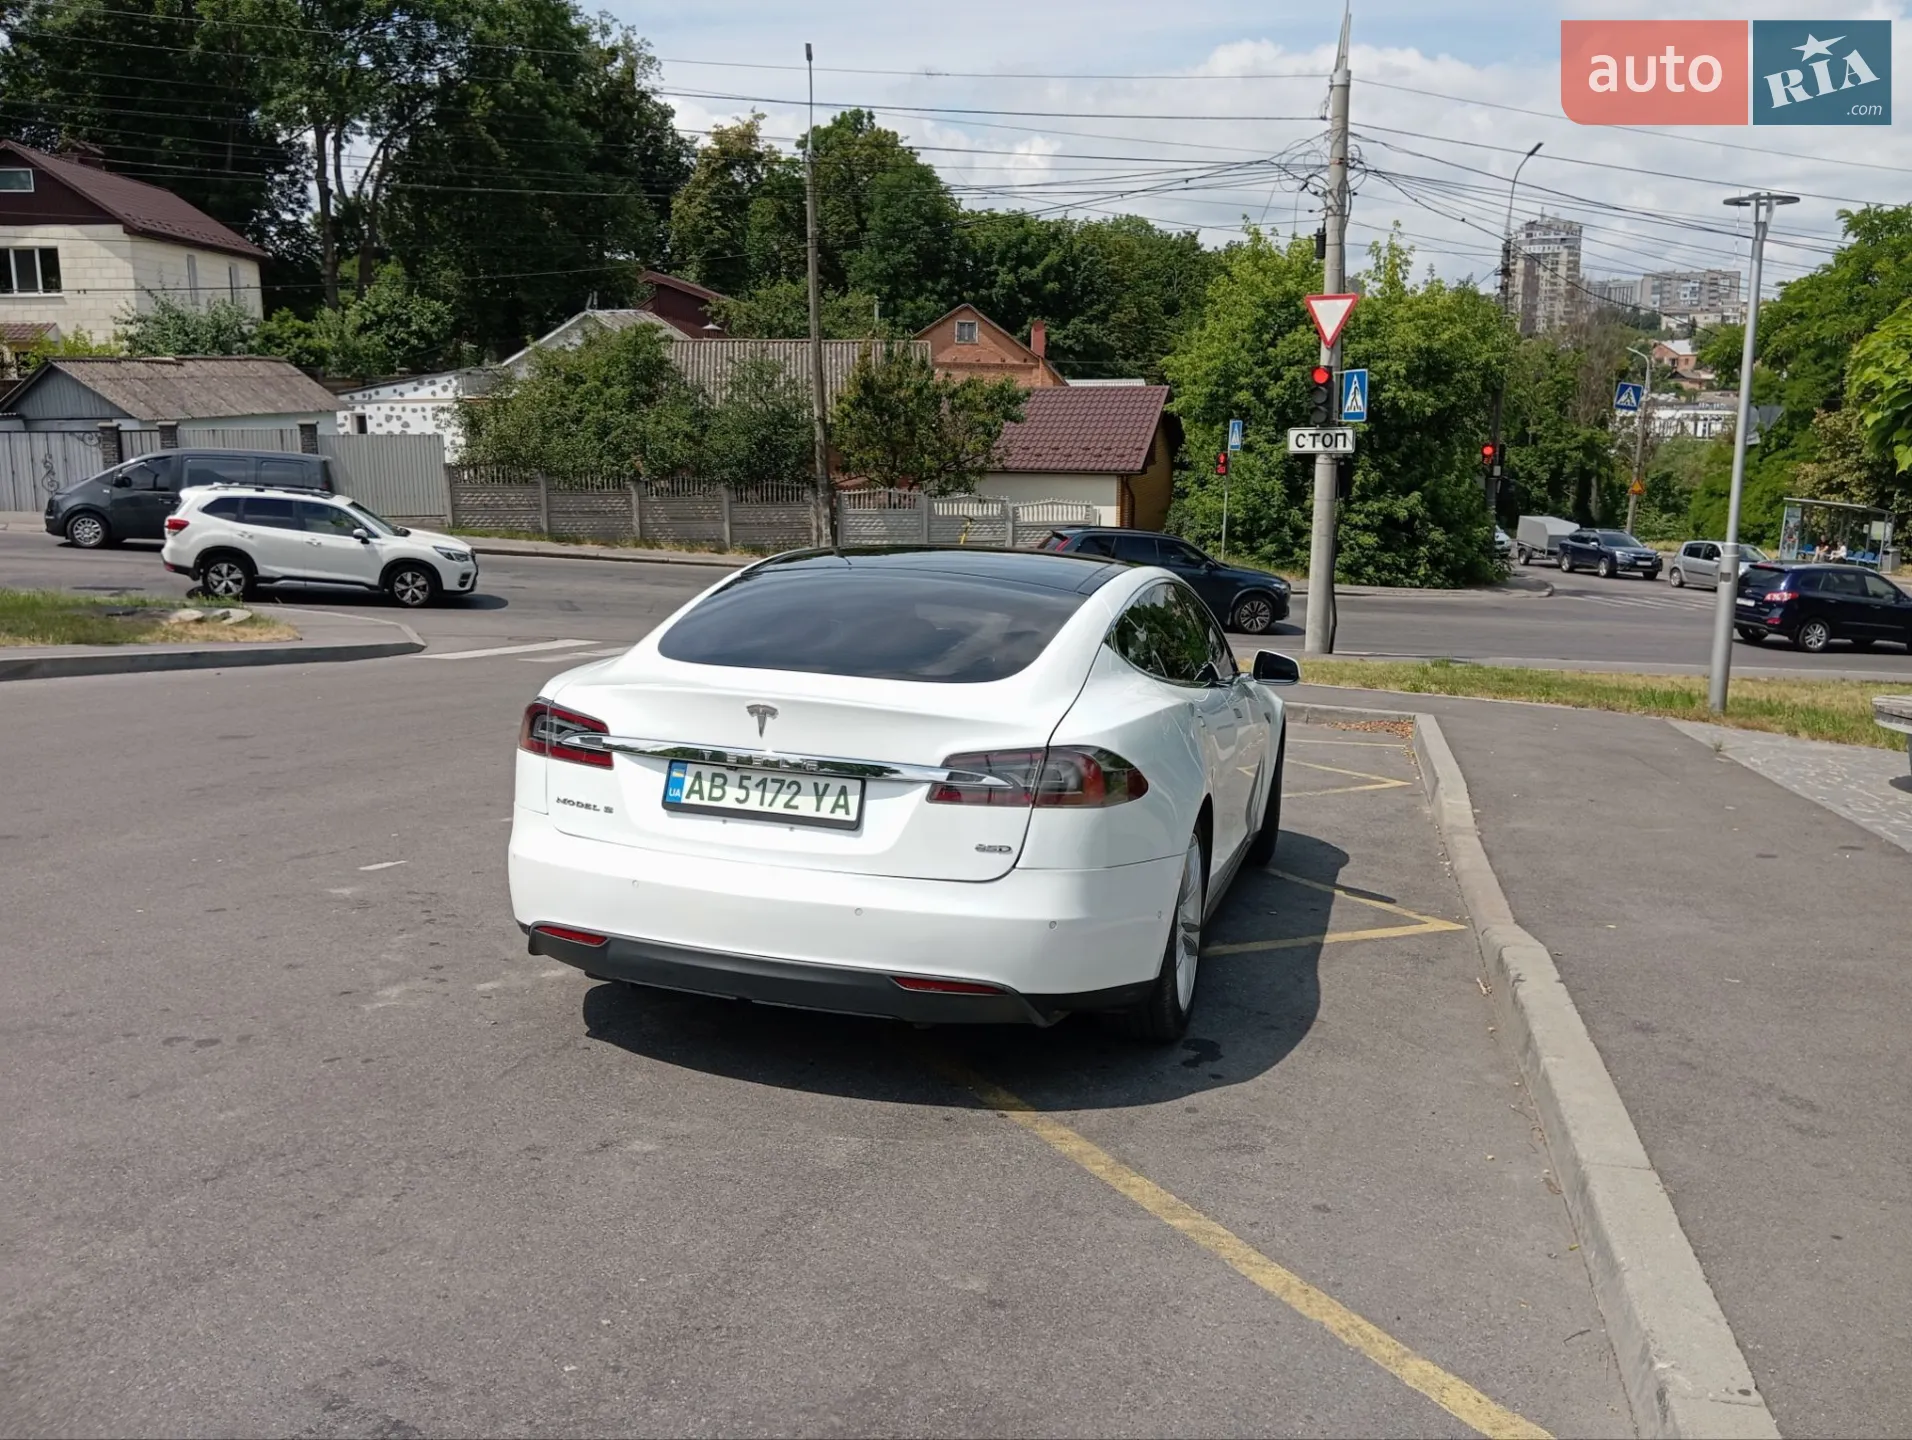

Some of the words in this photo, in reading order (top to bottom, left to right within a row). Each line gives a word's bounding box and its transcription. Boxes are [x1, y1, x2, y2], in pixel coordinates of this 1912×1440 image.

[1295, 433, 1347, 448] СТОП
[669, 785, 682, 798] UA
[685, 770, 728, 802] AB
[734, 775, 802, 810] 5172
[812, 781, 851, 816] YA
[556, 796, 601, 812] MODEL
